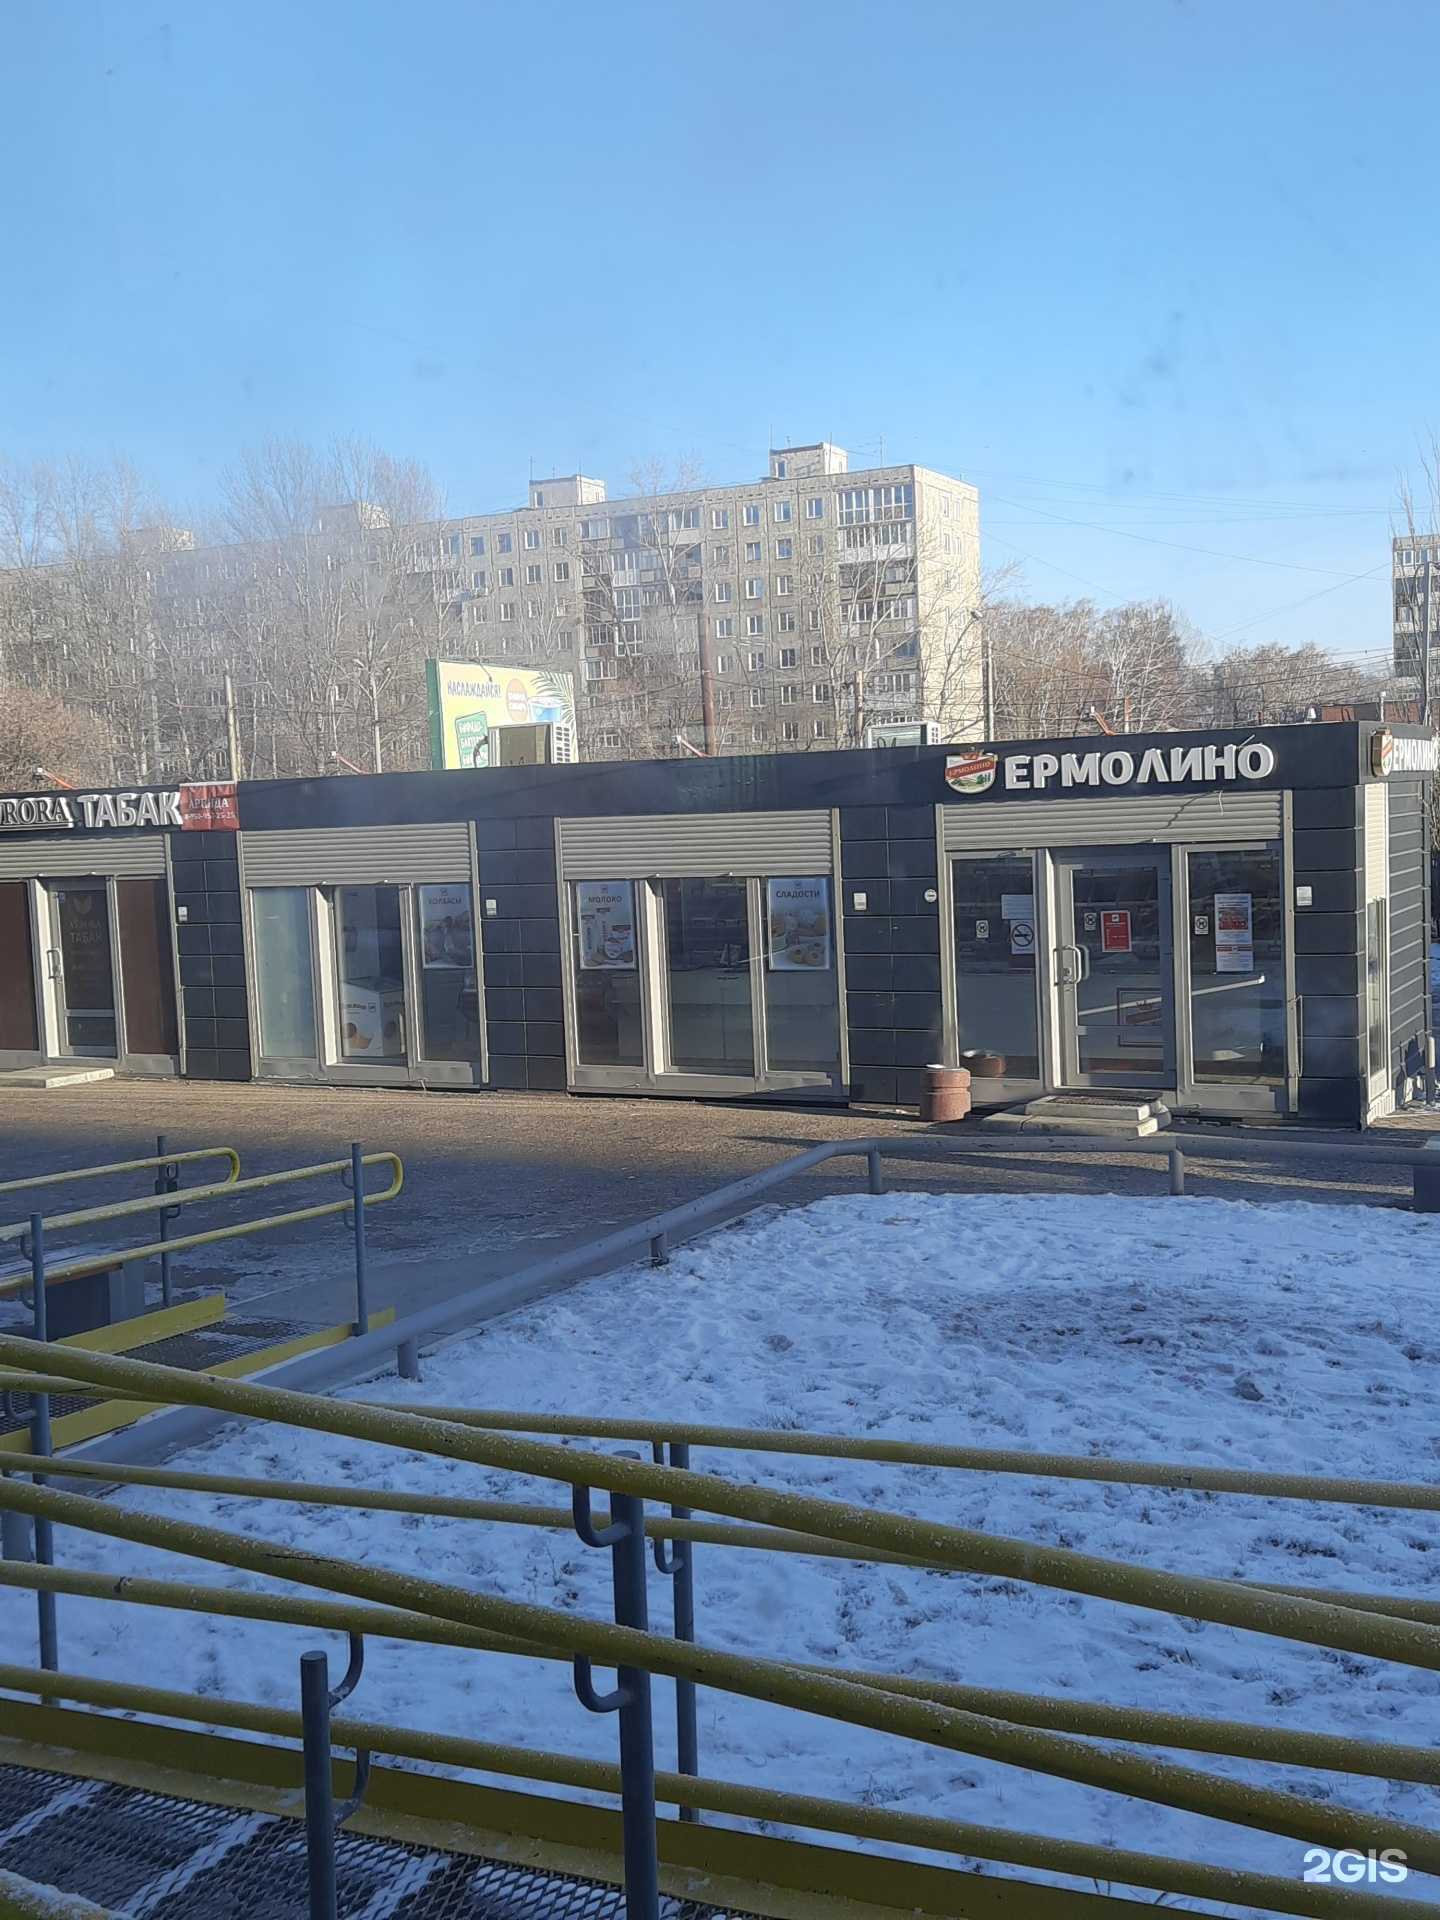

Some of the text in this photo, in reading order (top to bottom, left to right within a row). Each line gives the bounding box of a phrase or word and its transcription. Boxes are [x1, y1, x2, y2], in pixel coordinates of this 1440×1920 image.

[1004, 743, 1275, 790] ЕРМОЛИНО
[0, 797, 74, 825] RORA
[77, 791, 183, 828] ТАБАК
[588, 895, 623, 904] МОЛОКО
[775, 889, 821, 899] СЛАДОСТИ
